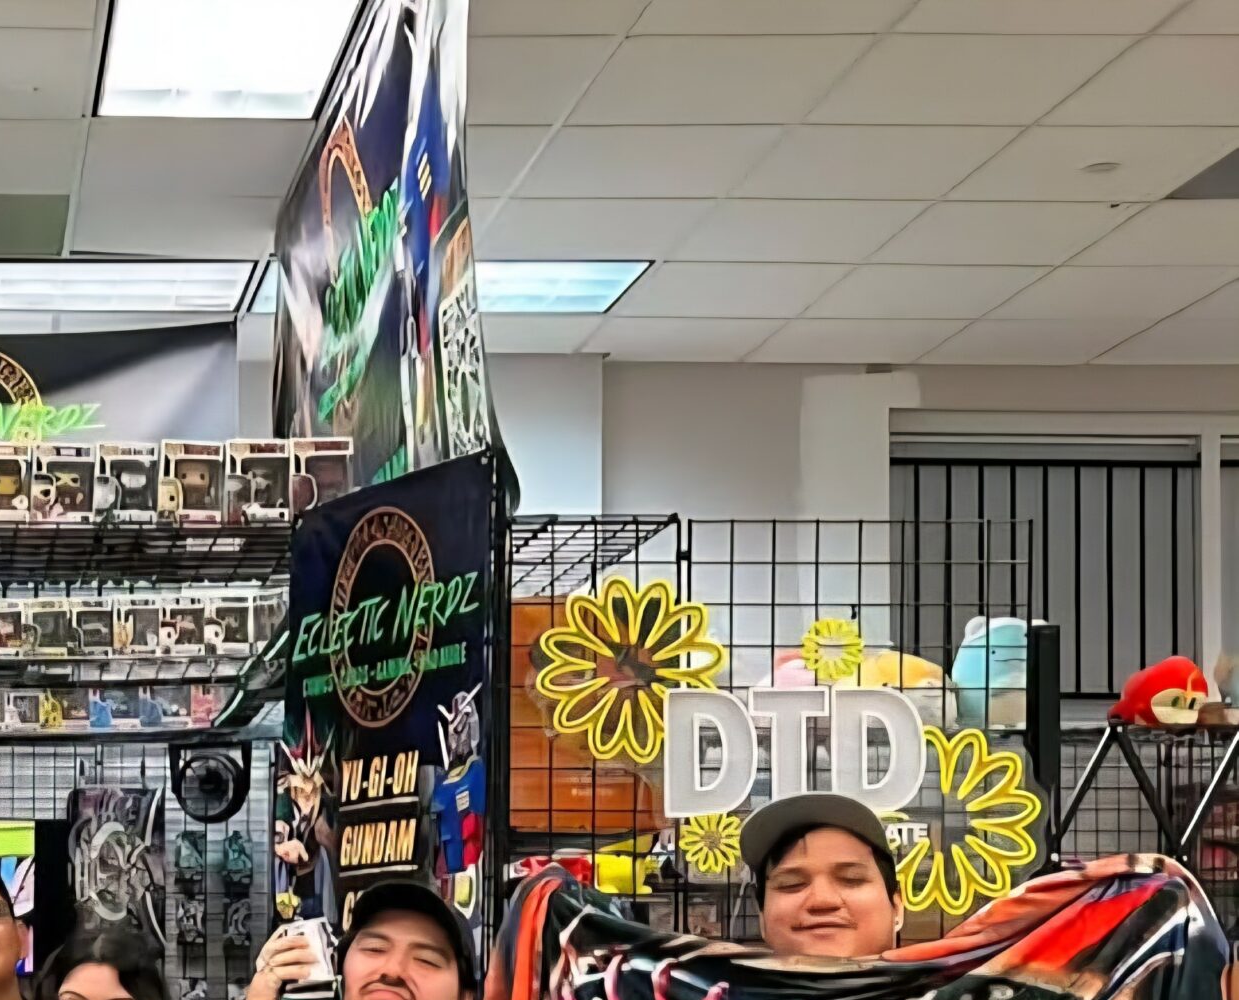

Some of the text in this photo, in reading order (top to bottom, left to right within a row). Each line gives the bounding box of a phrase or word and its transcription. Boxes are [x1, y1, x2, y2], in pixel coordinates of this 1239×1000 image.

[292, 571, 480, 662] ECLECTIC NERDZ
[341, 750, 419, 802] YU-GI-OH
[664, 686, 927, 818] DTD
[340, 818, 417, 866] GUNDAM
[886, 823, 928, 846] ATE
